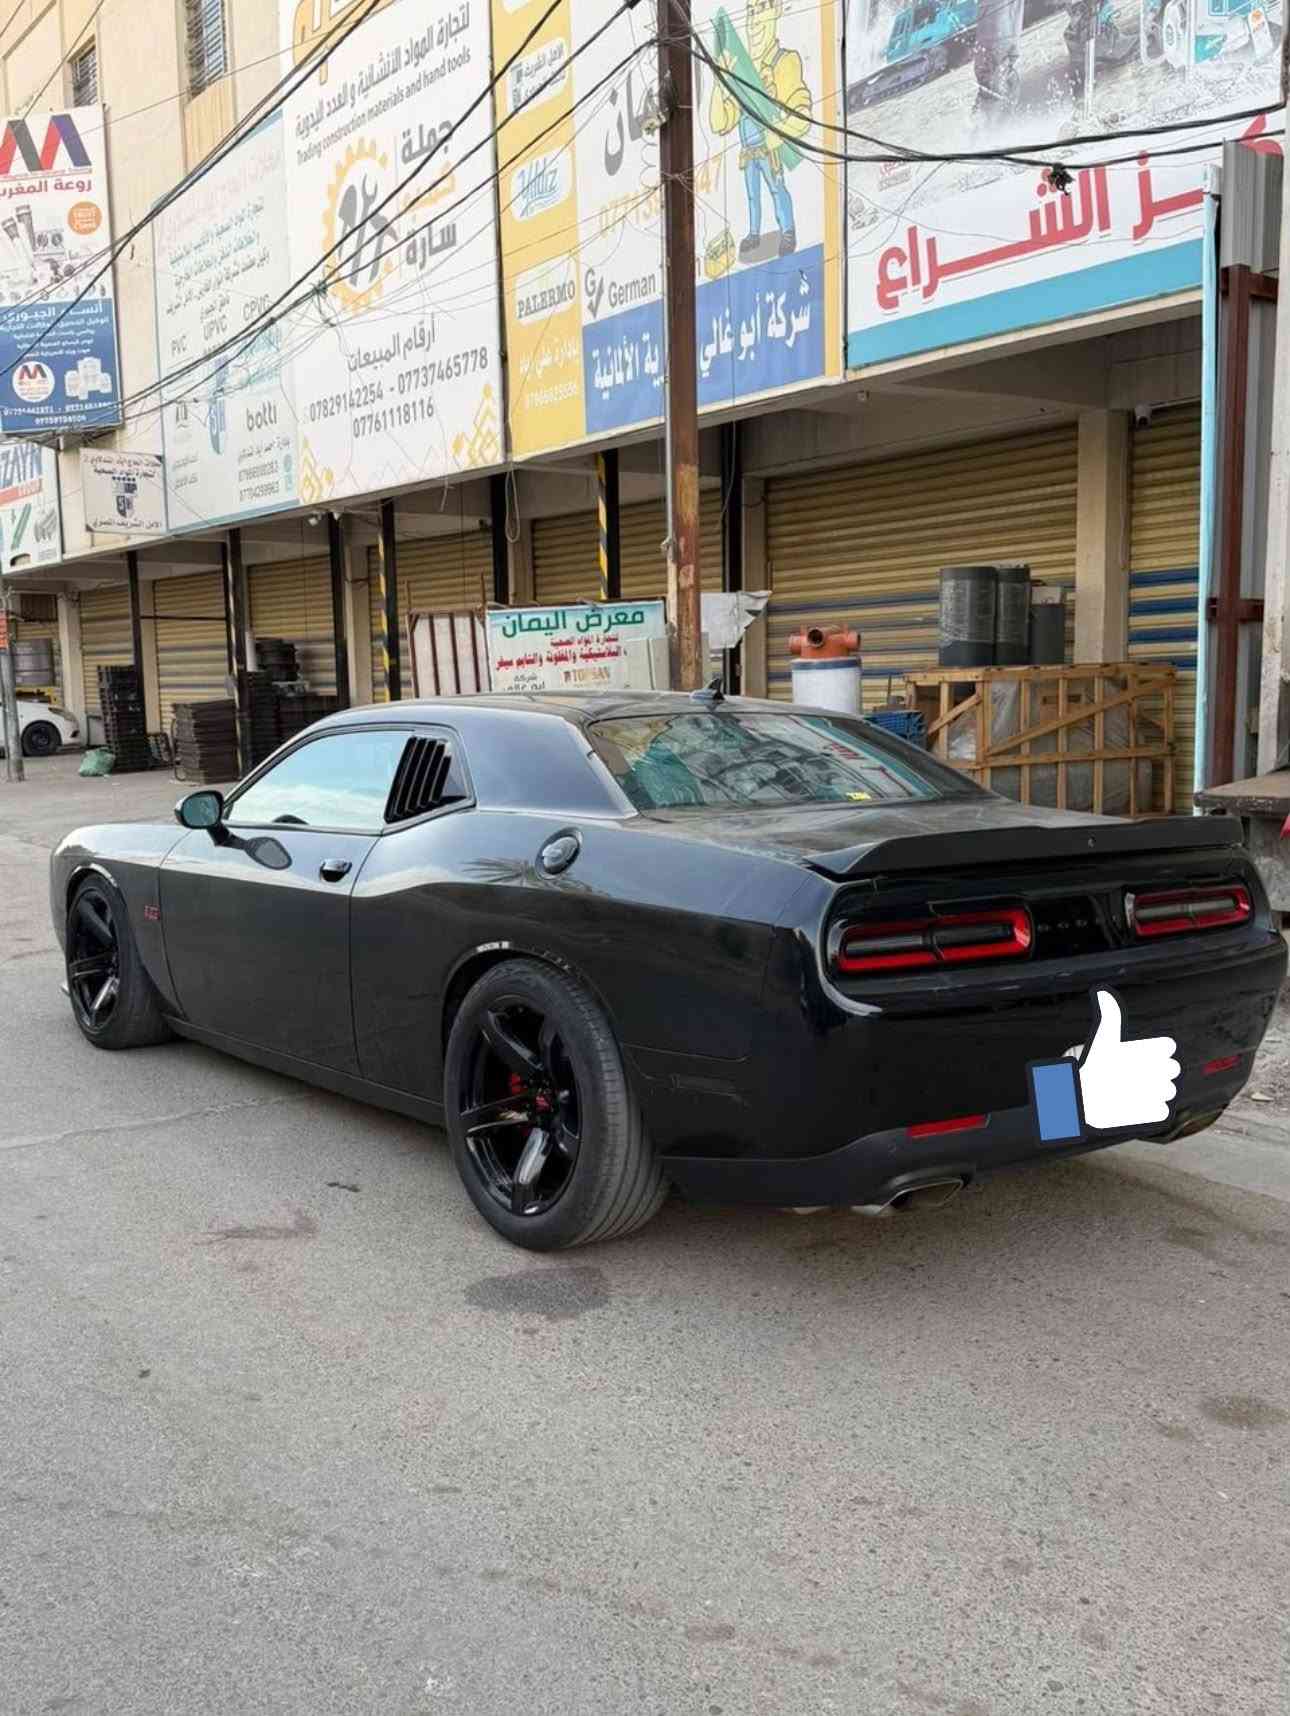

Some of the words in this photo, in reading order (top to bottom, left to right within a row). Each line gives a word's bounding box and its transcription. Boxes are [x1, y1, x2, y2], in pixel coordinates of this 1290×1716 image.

[54, 178, 92, 194] روعة
[877, 163, 1111, 311] الشراع
[517, 280, 576, 319] PALERMO
[608, 273, 656, 308] German
[765, 274, 811, 348] شركة
[699, 308, 734, 377] غالي
[738, 291, 761, 360] أبو
[349, 332, 400, 373] المبيعات
[398, 346, 488, 395] 07737465778
[502, 609, 566, 638] اليمان
[576, 607, 645, 633] معرض
